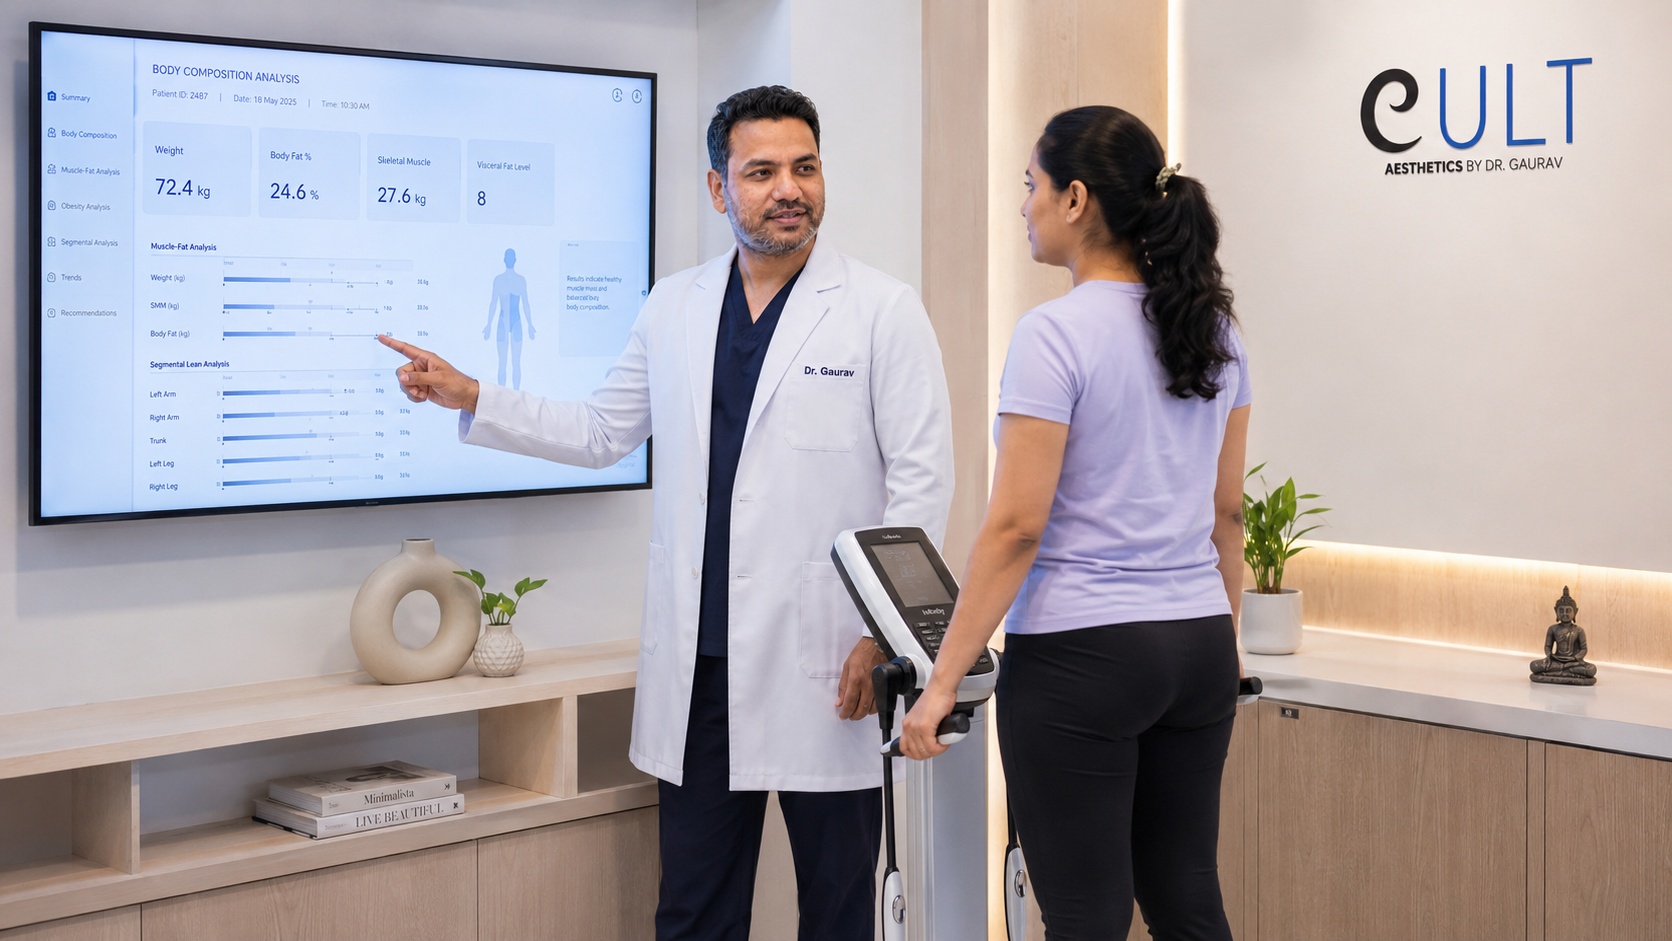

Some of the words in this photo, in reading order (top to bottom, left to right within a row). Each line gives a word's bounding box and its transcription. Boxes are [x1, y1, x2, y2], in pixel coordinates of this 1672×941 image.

[152, 64, 181, 76] BODY
[183, 66, 253, 81] COMPOSITION
[255, 72, 300, 84] ANALYSIS
[61, 93, 90, 103] Summary
[152, 89, 178, 98] Patient
[179, 91, 188, 99] ID:
[190, 92, 208, 100] 2487
[234, 94, 252, 103] Date:
[254, 95, 262, 104] 18
[263, 96, 278, 106] May
[279, 97, 297, 106] 2025
[359, 102, 370, 110] AM
[61, 130, 77, 139] Body
[79, 131, 117, 140] Composition
[155, 145, 184, 157] Weight
[270, 151, 290, 162] Body
[291, 152, 303, 161] Fat
[304, 152, 312, 161] %
[377, 155, 405, 166] Skeletal
[406, 157, 431, 167] Muscle
[477, 160, 502, 170] Visceral
[503, 162, 513, 171] Fat
[514, 163, 531, 172] Level
[1385, 160, 1463, 175] AESTHETICS
[1466, 159, 1483, 172] BY
[1485, 159, 1506, 172] DR.
[1509, 157, 1563, 171] GAURAV
[61, 166, 95, 175] Muscle-Fat
[96, 167, 121, 176] Analysis
[155, 178, 193, 196] 72.4
[197, 185, 211, 200] kg
[270, 182, 306, 200] 24.6
[309, 189, 320, 200] %
[377, 186, 411, 204] 27.6
[414, 193, 427, 207] kg
[477, 190, 486, 206] 8
[61, 202, 85, 212] Obesity
[86, 203, 111, 212] Analysis
[61, 238, 93, 248] Segmental
[94, 239, 119, 248] Analysis
[150, 242, 189, 251] Muscle-Fat
[189, 243, 217, 253] Analysis
[61, 273, 82, 282] Trends
[150, 274, 173, 283] Weight
[150, 301, 167, 309] SMM
[61, 309, 117, 317] Recommendations
[150, 330, 166, 339] Body
[167, 330, 177, 338] Fat
[150, 361, 185, 370] Segmental
[186, 361, 202, 369] Lean
[203, 360, 230, 370] Analysis
[804, 366, 817, 375] Dr.
[820, 366, 855, 377] Gaurav
[149, 414, 166, 423] Right
[149, 460, 162, 468] Left
[162, 460, 175, 469] Leg
[149, 483, 166, 492] Right
[166, 483, 178, 491] Leg
[363, 789, 415, 806] Minimalista
[355, 814, 382, 828] LIVE
[384, 802, 444, 824] BEAUTIFUL
